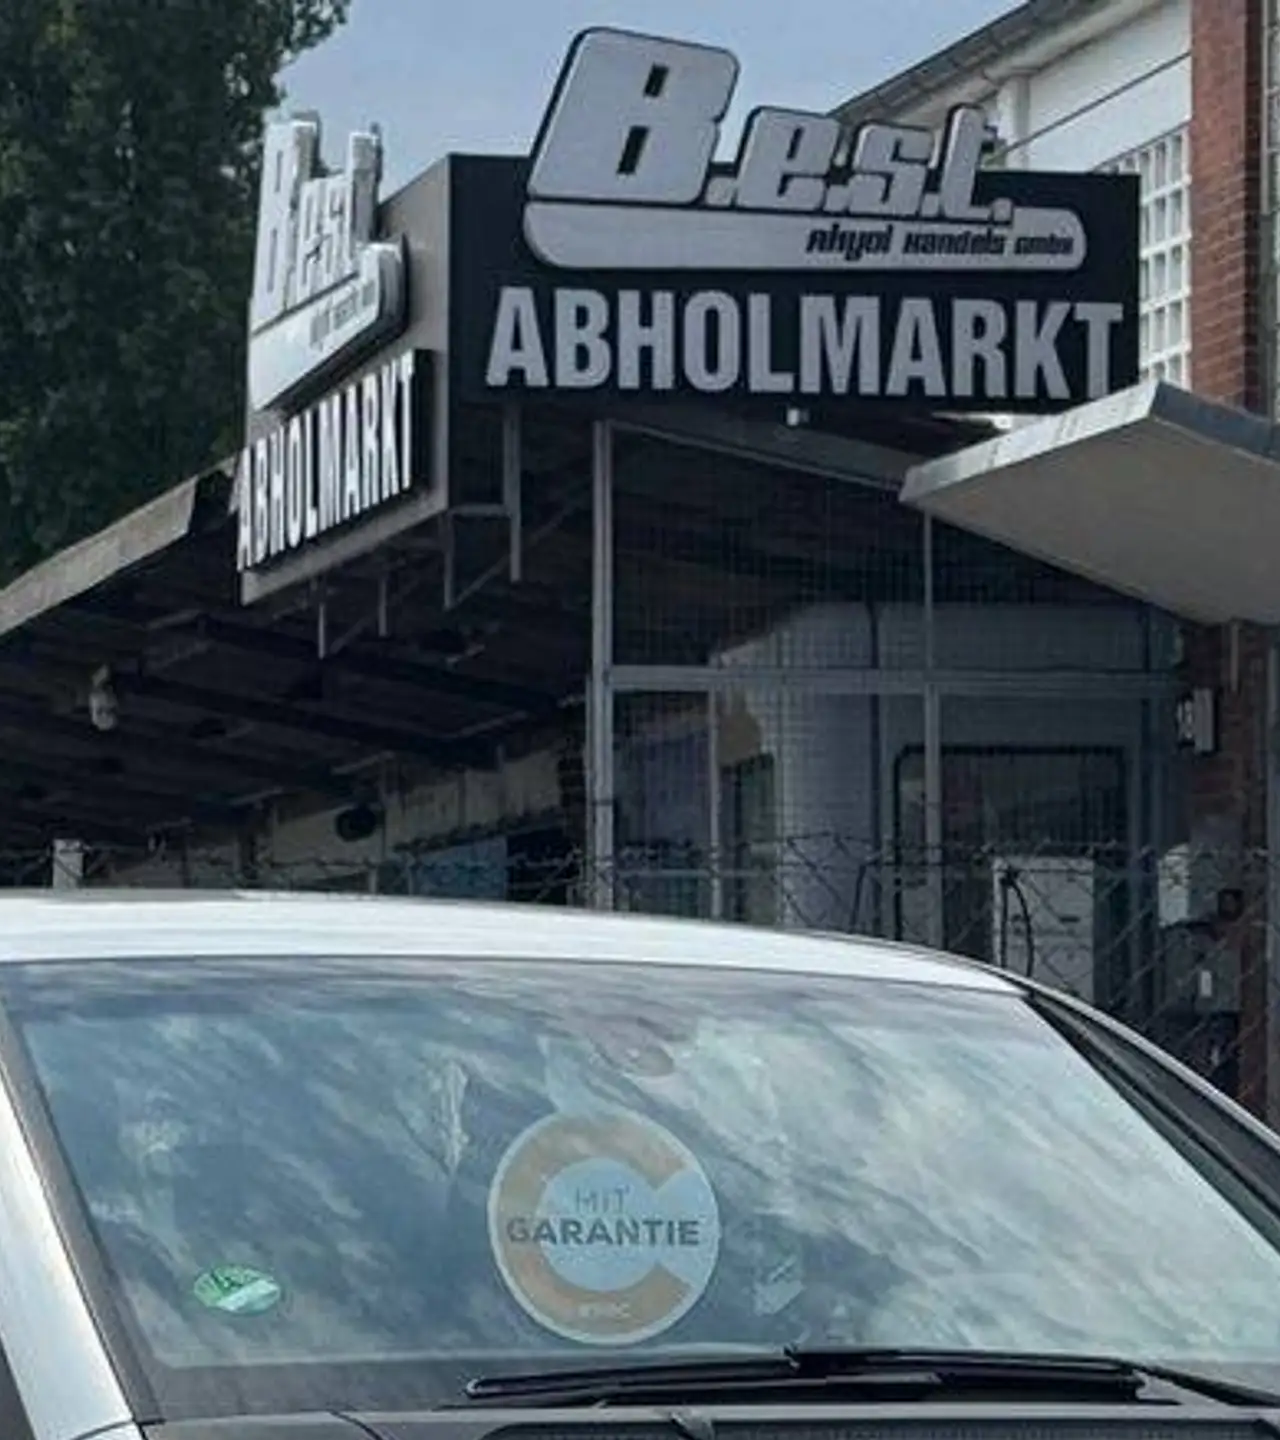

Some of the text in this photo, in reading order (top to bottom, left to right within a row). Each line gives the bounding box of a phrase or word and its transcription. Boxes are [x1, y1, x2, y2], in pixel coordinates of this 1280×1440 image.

[486, 286, 1124, 398] ABHOLMARKT
[236, 350, 414, 572] ABHOLMARKT
[506, 1217, 700, 1247] GARANTIE
